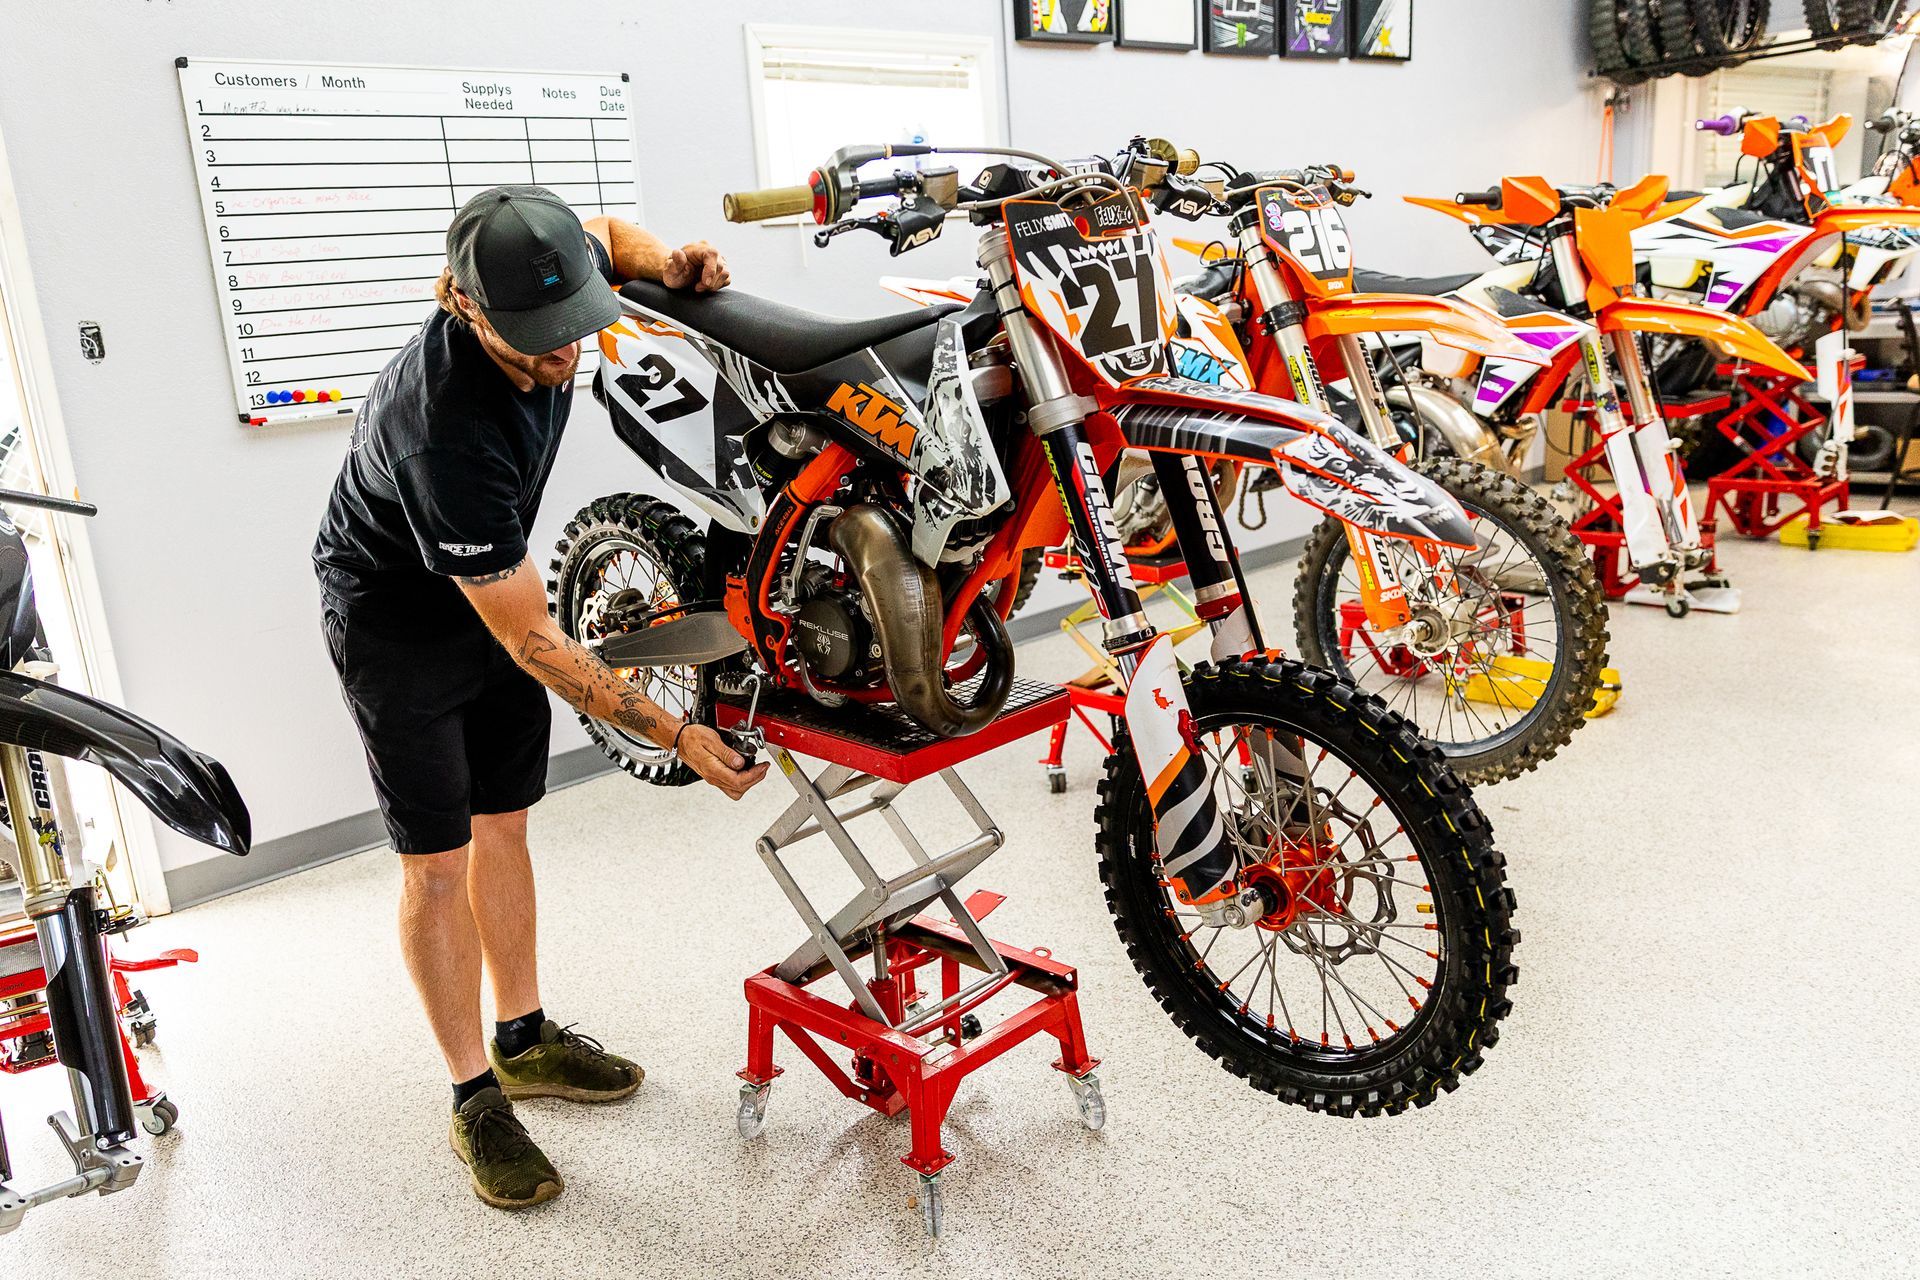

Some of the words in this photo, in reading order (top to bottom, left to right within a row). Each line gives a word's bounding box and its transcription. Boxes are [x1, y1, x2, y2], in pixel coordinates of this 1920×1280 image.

[214, 72, 297, 87] Customers
[322, 76, 366, 89] Month
[462, 82, 512, 97] Supplys
[542, 88, 577, 99] Notes
[600, 86, 621, 97] Due
[196, 99, 203, 112] 1
[465, 98, 513, 110] Needed
[600, 101, 625, 111] Date
[201, 124, 211, 138] 2
[206, 150, 216, 163] 3
[211, 176, 221, 188] 4
[215, 201, 225, 214] 5
[1170, 199, 1207, 216] ASV
[219, 225, 230, 238] 6
[830, 222, 859, 237] ASV
[901, 223, 943, 251] ASV
[1282, 208, 1352, 272] 216
[223, 251, 232, 263] 7
[228, 275, 238, 288] 8
[232, 299, 242, 312] 9
[1059, 253, 1160, 359] 27
[236, 323, 253, 336] 10
[241, 347, 254, 360] 11
[245, 371, 261, 383] 12
[615, 353, 709, 424] 27
[249, 394, 265, 406] 13
[825, 380, 919, 460] KTM
[1042, 440, 1060, 484] RACE
[1057, 482, 1075, 525] TECH
[1076, 441, 1138, 593] CROW
[1085, 497, 1117, 583] PERFORMANCE
[439, 542, 464, 554] RACE
[465, 543, 493, 553] TECH
[1373, 537, 1395, 582] LOP
[799, 619, 849, 641] REKLUSE
[25, 750, 51, 810] CRO
